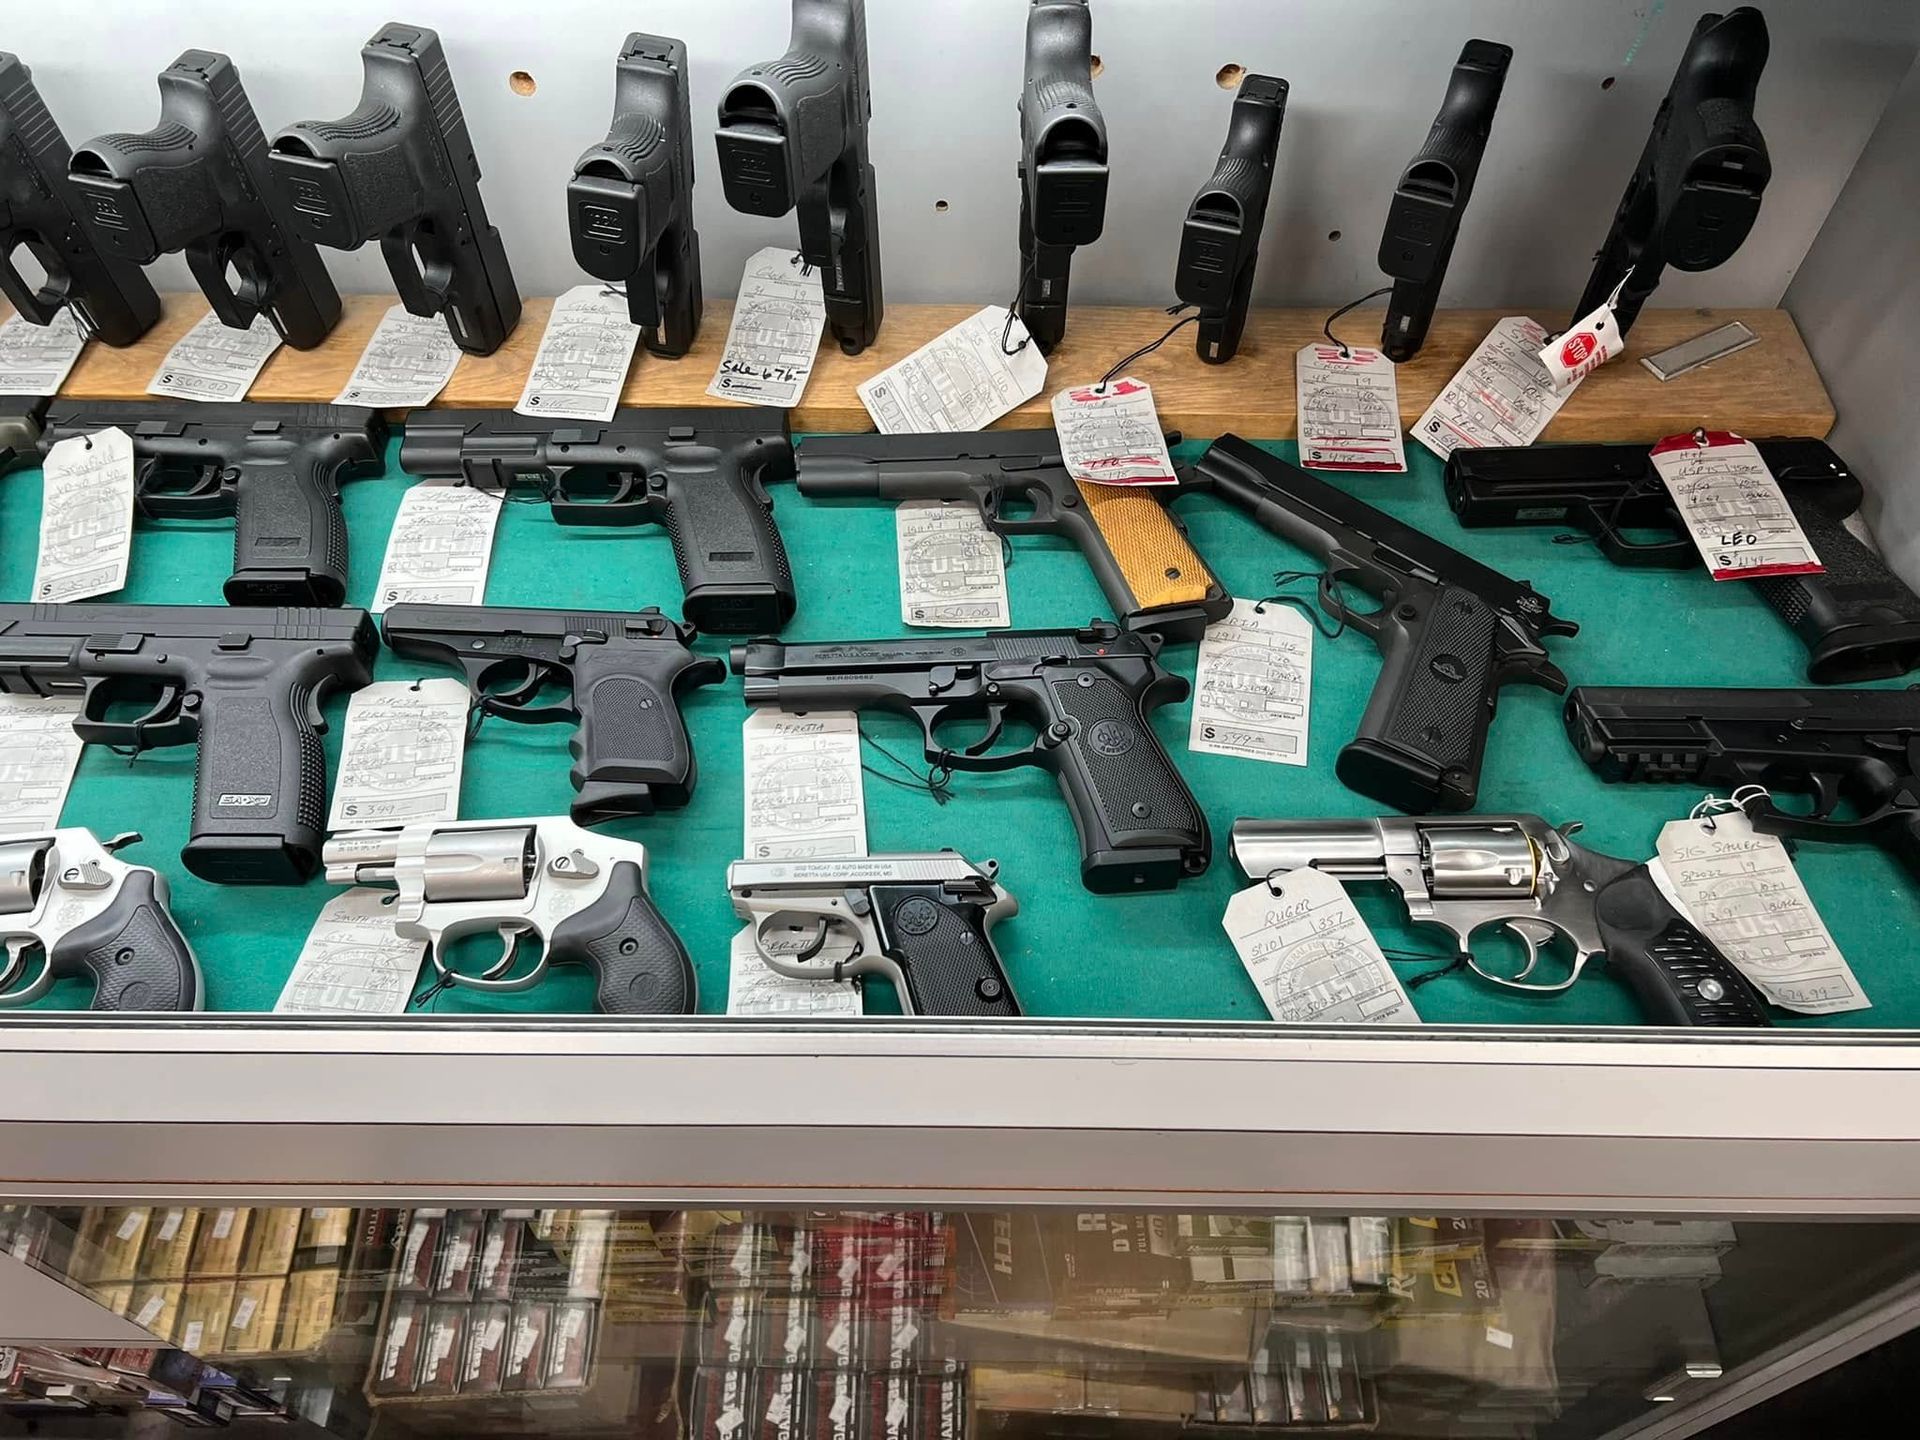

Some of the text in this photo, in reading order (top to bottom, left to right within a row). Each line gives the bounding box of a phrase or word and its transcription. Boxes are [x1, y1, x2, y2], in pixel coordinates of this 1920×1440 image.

[1567, 337, 1588, 361] STOP
[720, 360, 758, 374] Sale
[1722, 532, 1757, 545] LEO
[1318, 912, 1344, 930] 357
